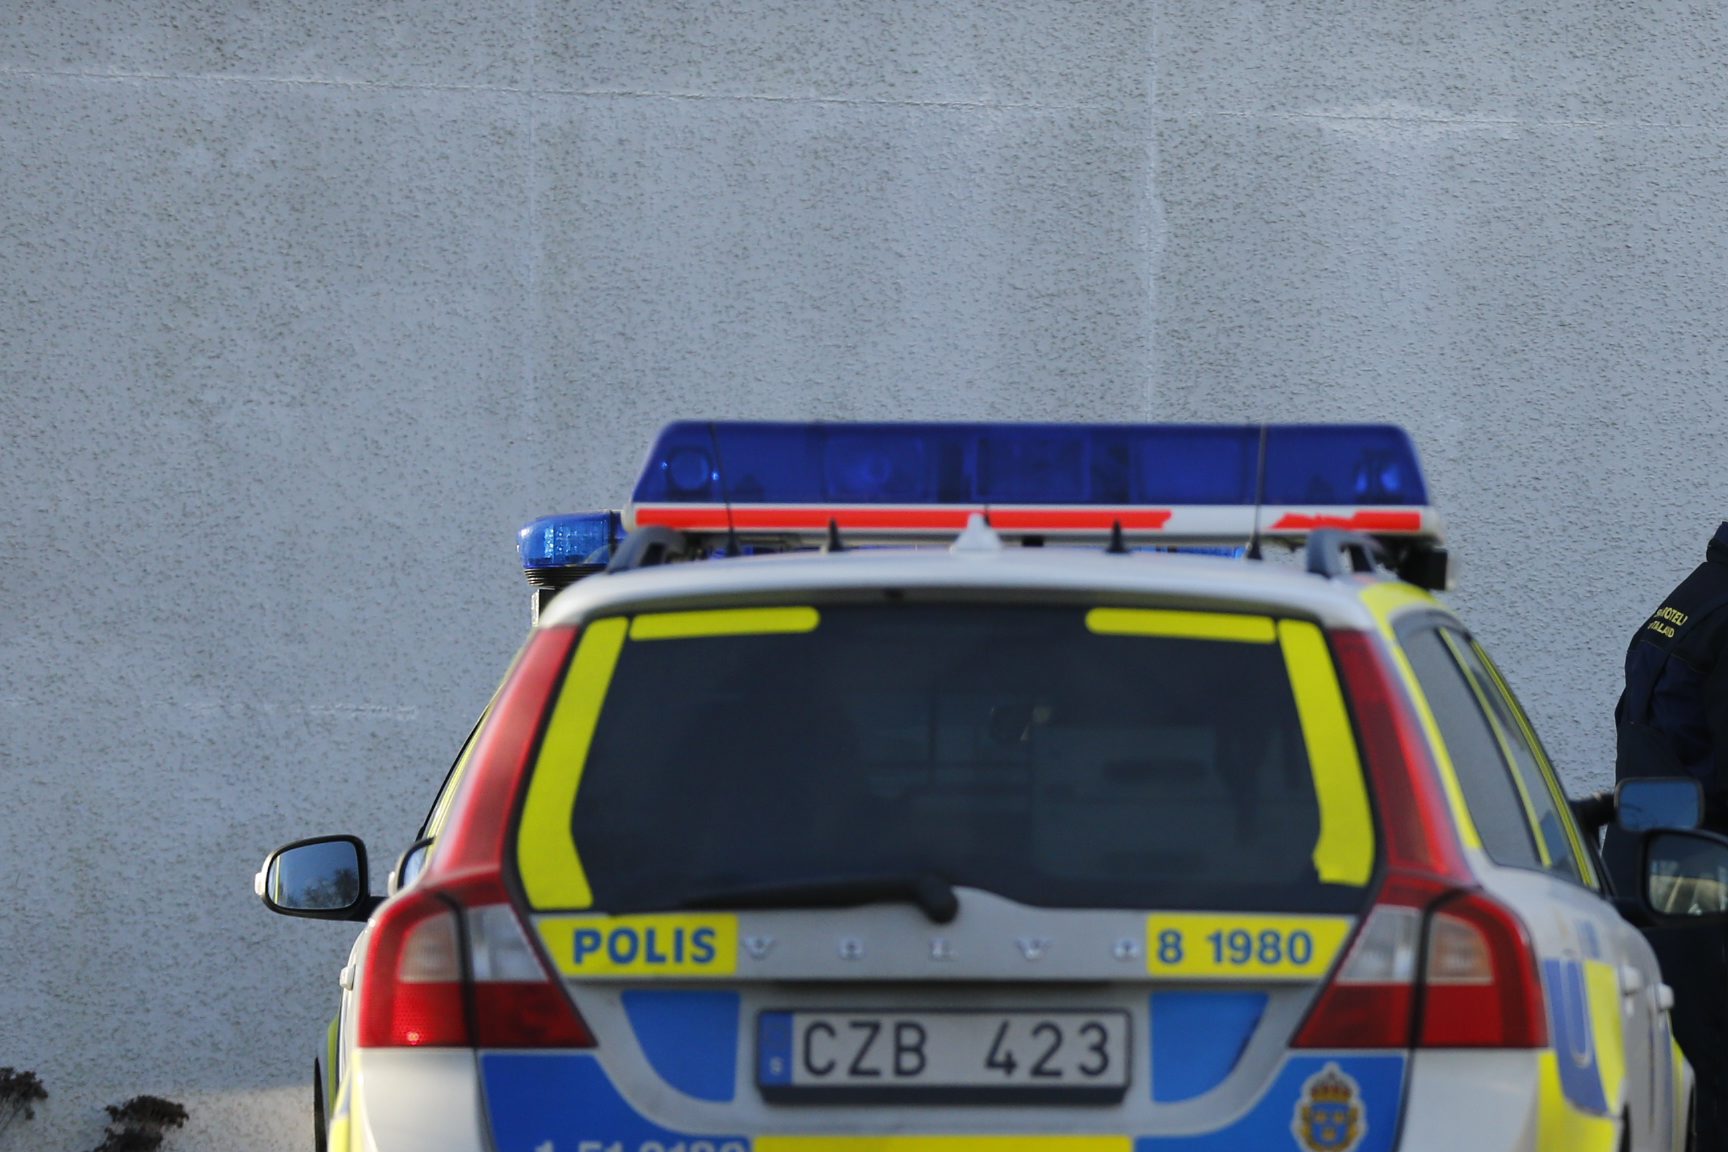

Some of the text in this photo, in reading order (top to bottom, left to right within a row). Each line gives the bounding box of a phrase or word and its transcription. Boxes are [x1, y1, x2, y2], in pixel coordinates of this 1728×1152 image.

[572, 926, 717, 965] POLIS
[1157, 928, 1314, 965] 8 1980
[802, 1020, 1110, 1078] CZB 423
